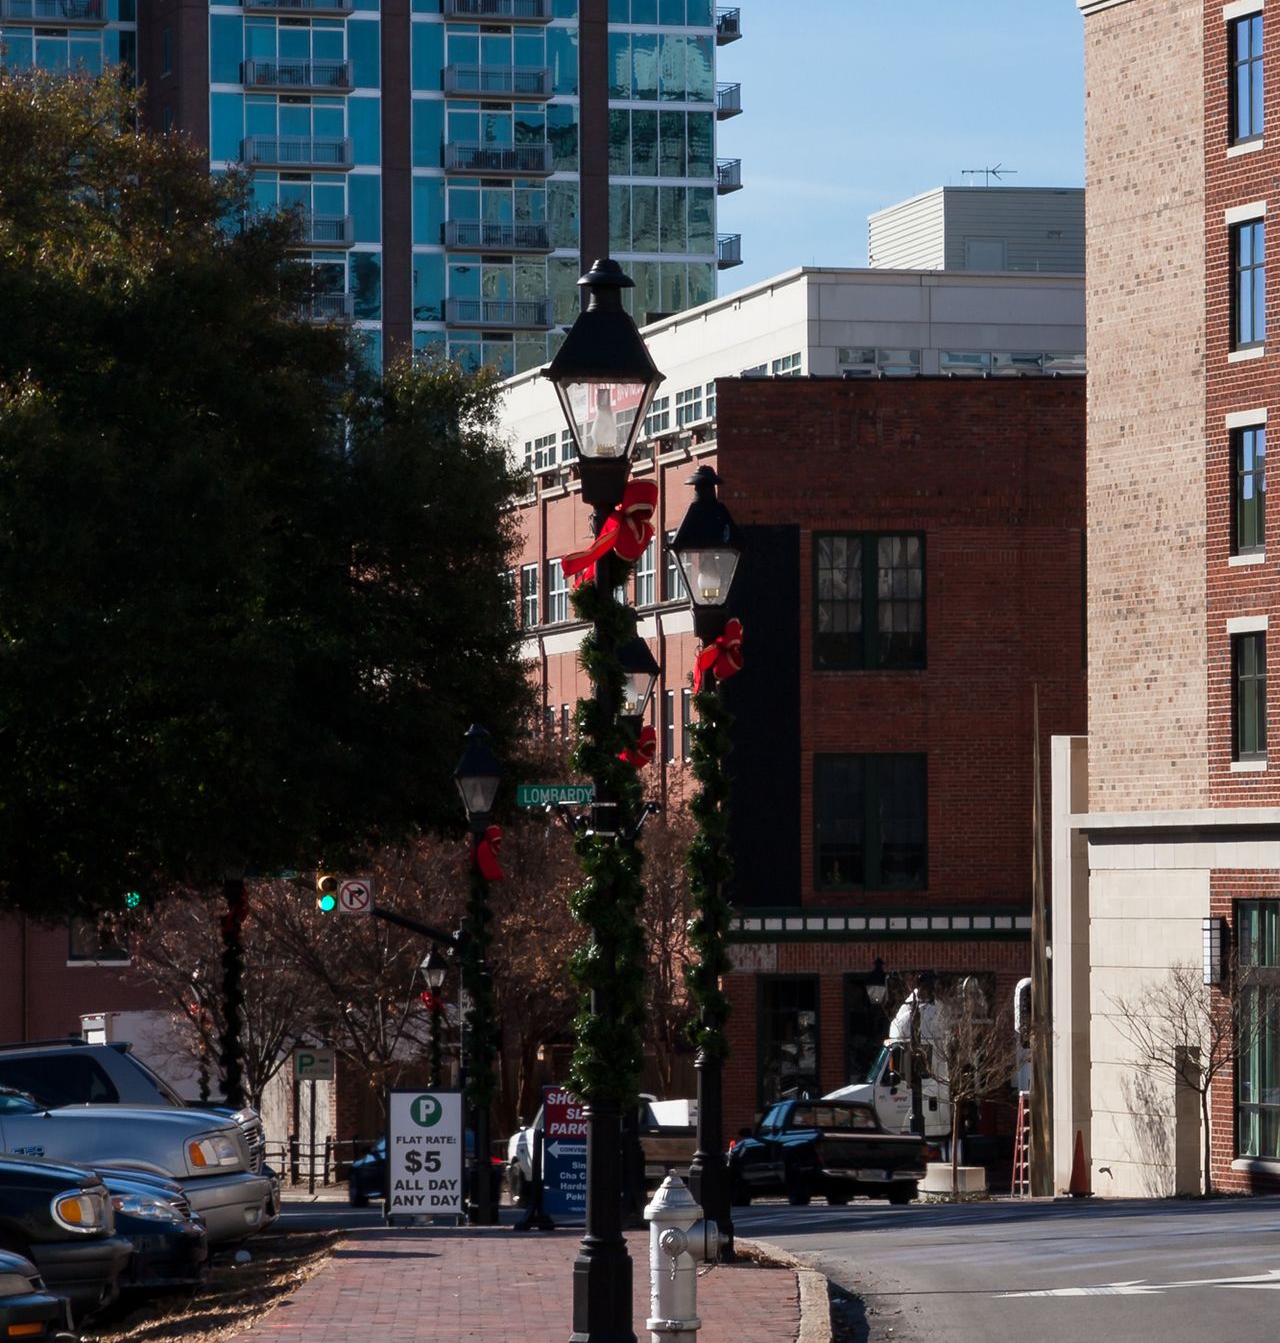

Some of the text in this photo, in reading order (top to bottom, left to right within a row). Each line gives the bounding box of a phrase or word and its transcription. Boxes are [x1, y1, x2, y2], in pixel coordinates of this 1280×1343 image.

[523, 788, 592, 804] LOMBARDY
[550, 1123, 587, 1135] PARK
[396, 1136, 457, 1145] FLAT RATE:
[404, 1149, 442, 1176] $5
[572, 1161, 587, 1170] Sin
[394, 1179, 458, 1191] ALL DAY
[392, 1195, 460, 1207] ANY DAY
[566, 1193, 586, 1201] Peki
